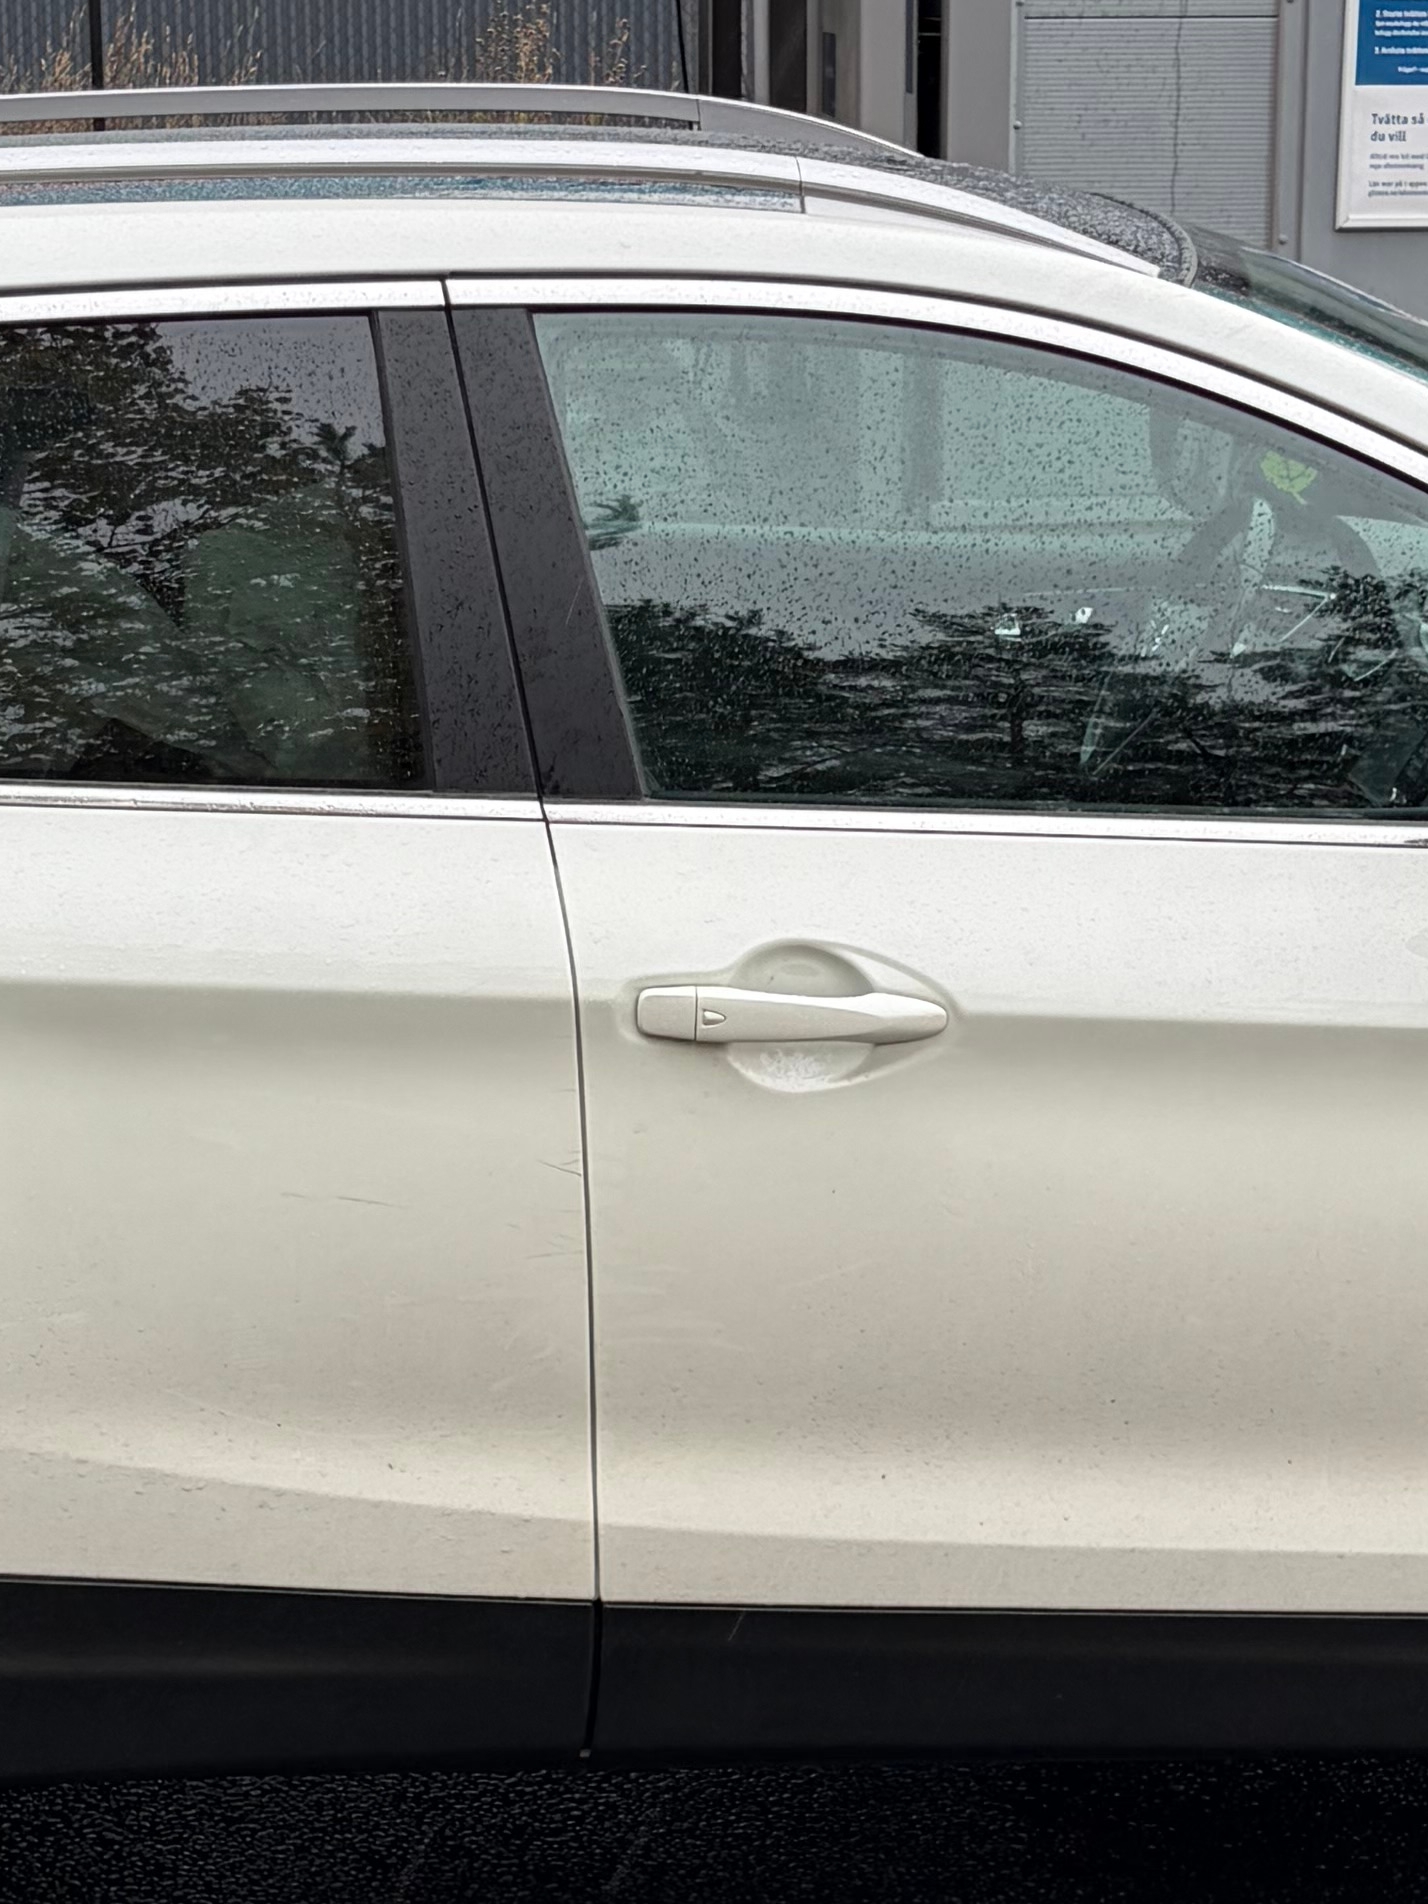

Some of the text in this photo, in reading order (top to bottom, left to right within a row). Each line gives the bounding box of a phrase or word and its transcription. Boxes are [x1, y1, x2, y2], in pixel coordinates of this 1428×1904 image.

[1371, 112, 1409, 125] Tvätta
[1411, 112, 1423, 125] så
[1370, 131, 1407, 142] du vill
